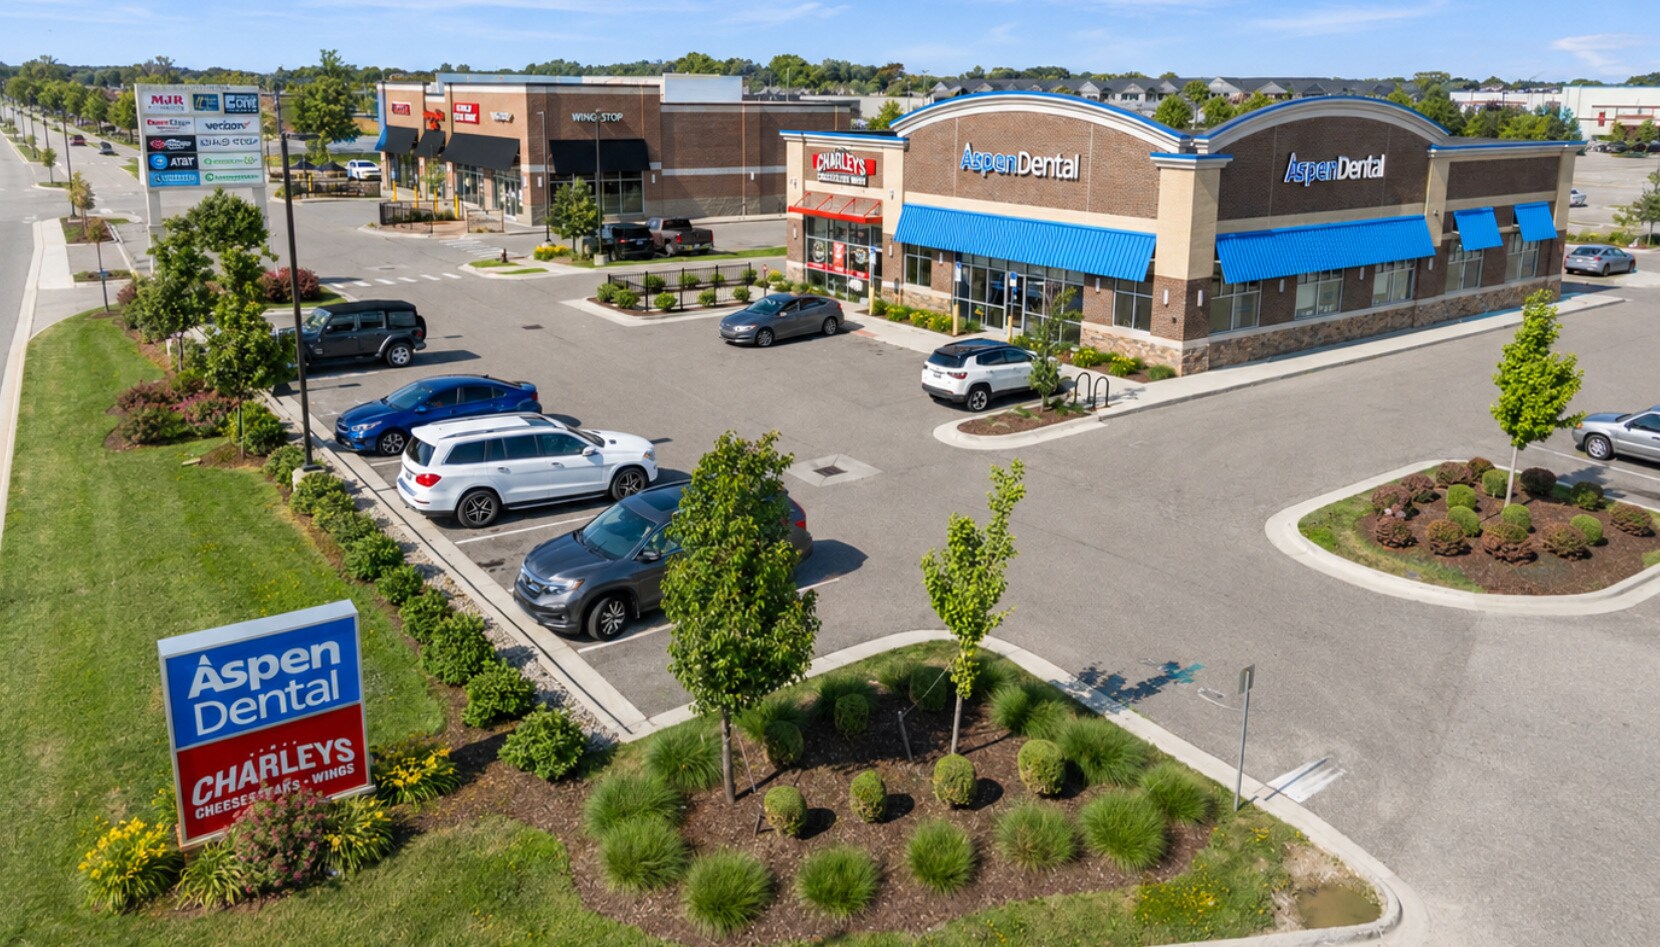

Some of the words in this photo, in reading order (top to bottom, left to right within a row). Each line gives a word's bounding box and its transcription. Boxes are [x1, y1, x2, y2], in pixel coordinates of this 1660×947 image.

[151, 95, 184, 105] MJR
[205, 120, 248, 131] verizon
[571, 112, 597, 122] WING
[600, 112, 624, 122] STOP
[170, 156, 195, 167] AT&T
[816, 151, 867, 176] CHARLEYS
[188, 640, 341, 699] Aspen
[194, 669, 340, 736] Dental
[192, 737, 356, 806] CHARLEYS
[312, 763, 355, 784] WINGS
